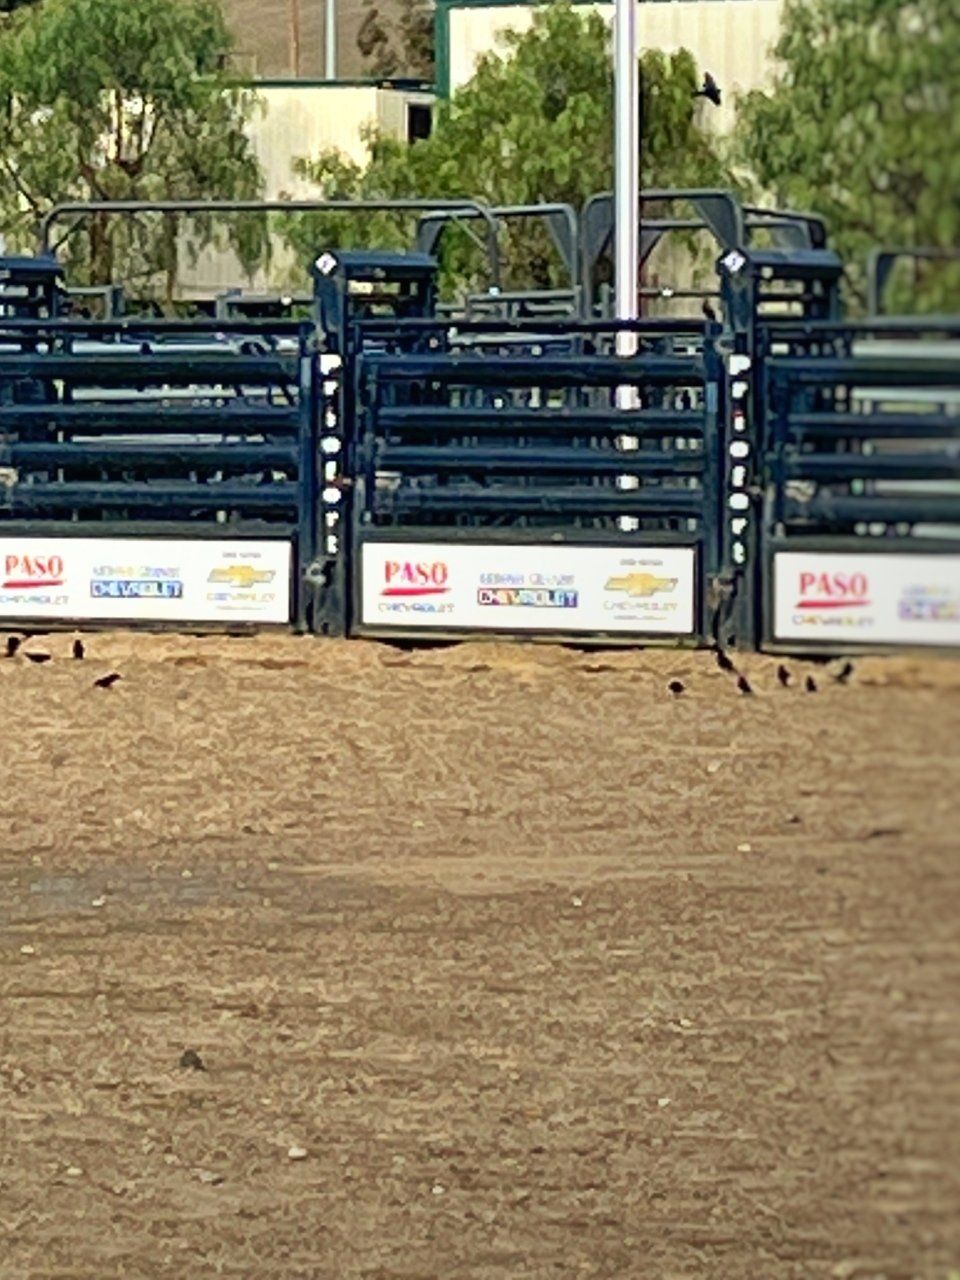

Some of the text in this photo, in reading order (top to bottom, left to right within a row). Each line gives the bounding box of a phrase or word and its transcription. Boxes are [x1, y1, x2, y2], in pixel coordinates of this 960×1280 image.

[5, 554, 64, 578] PASO
[384, 560, 449, 583] PASO
[799, 572, 869, 597] PASO
